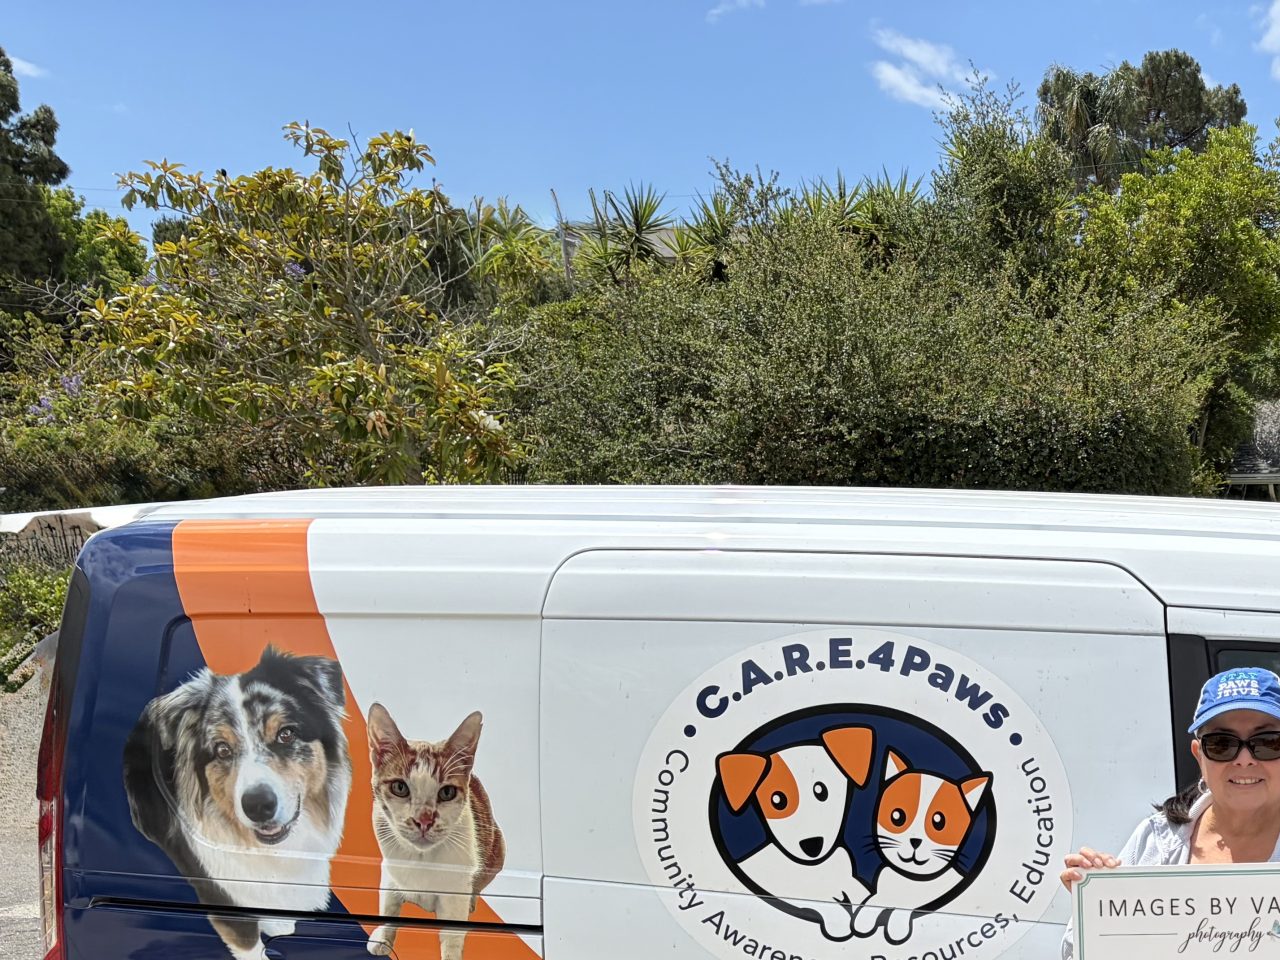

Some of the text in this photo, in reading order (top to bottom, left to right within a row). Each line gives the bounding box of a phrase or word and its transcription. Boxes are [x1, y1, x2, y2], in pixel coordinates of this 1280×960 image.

[696, 637, 1010, 730] C.A.R.E.4Paws
[1218, 679, 1260, 691] PAWS
[1220, 672, 1258, 683] STAY
[652, 749, 704, 912] Community
[1010, 756, 1054, 904] Education
[1099, 897, 1197, 917] IMAGES
[1210, 896, 1238, 916] BY
[1177, 917, 1266, 954] photography
